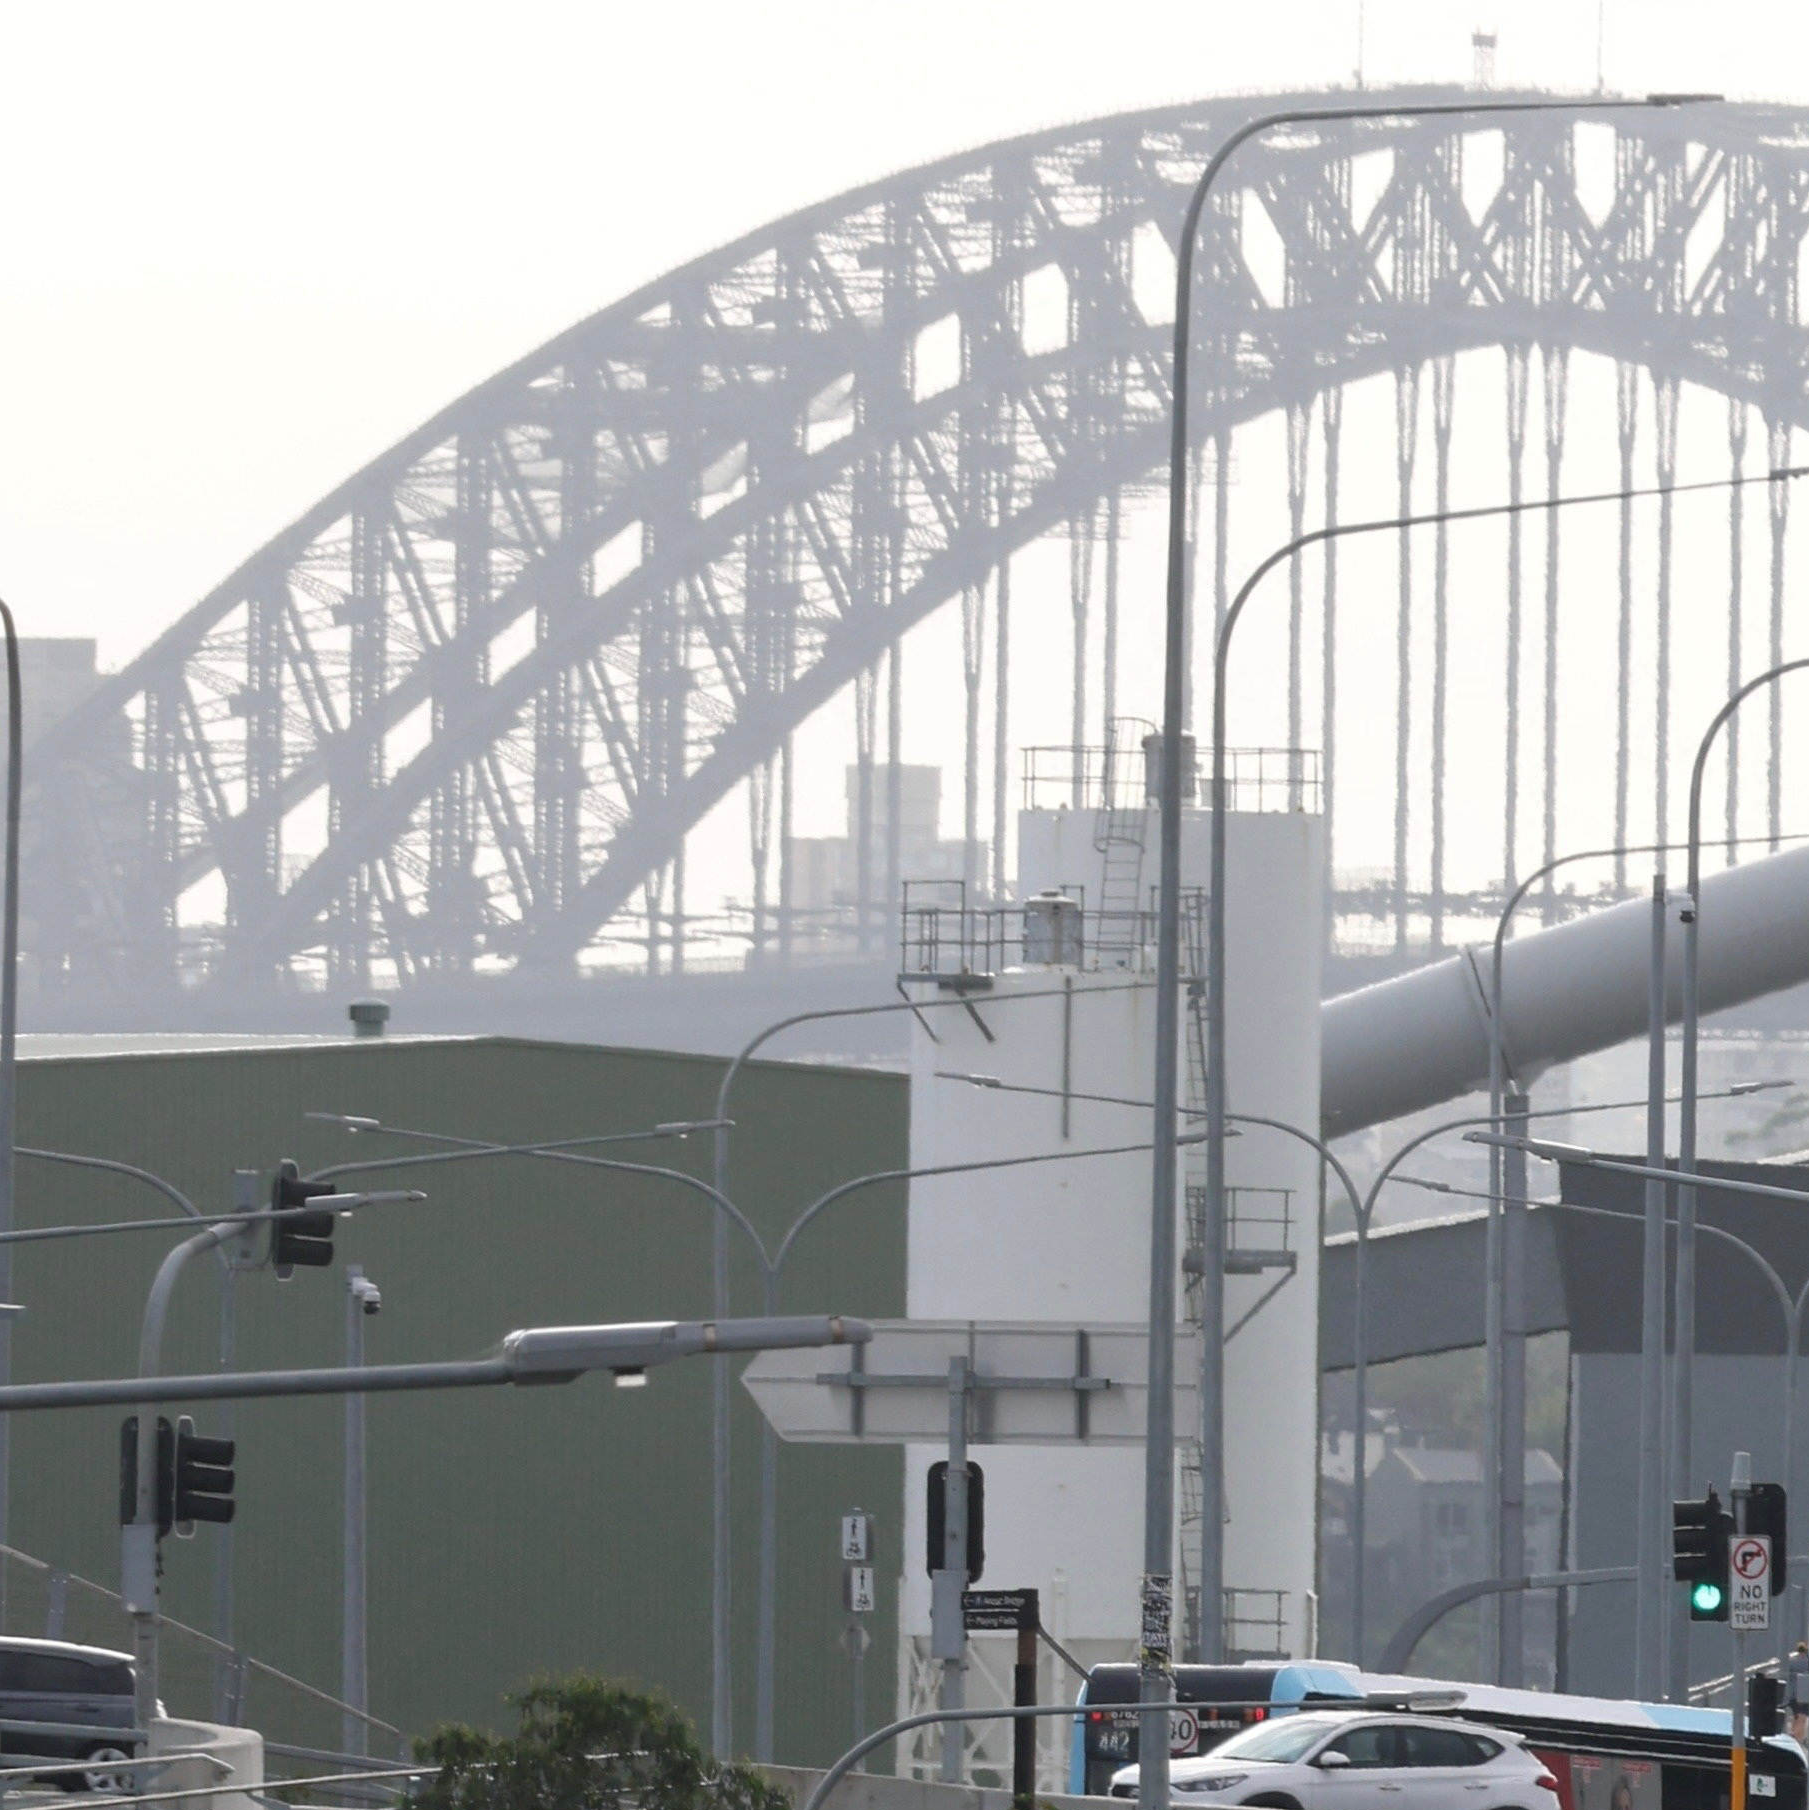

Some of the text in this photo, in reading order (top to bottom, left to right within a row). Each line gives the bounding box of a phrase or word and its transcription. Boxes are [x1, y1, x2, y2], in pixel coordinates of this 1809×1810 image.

[1741, 1585, 1763, 1600] NO
[1734, 1601, 1767, 1613] RIGHT
[1735, 1612, 1766, 1625] TURN
[1099, 1729, 1130, 1752] 442
